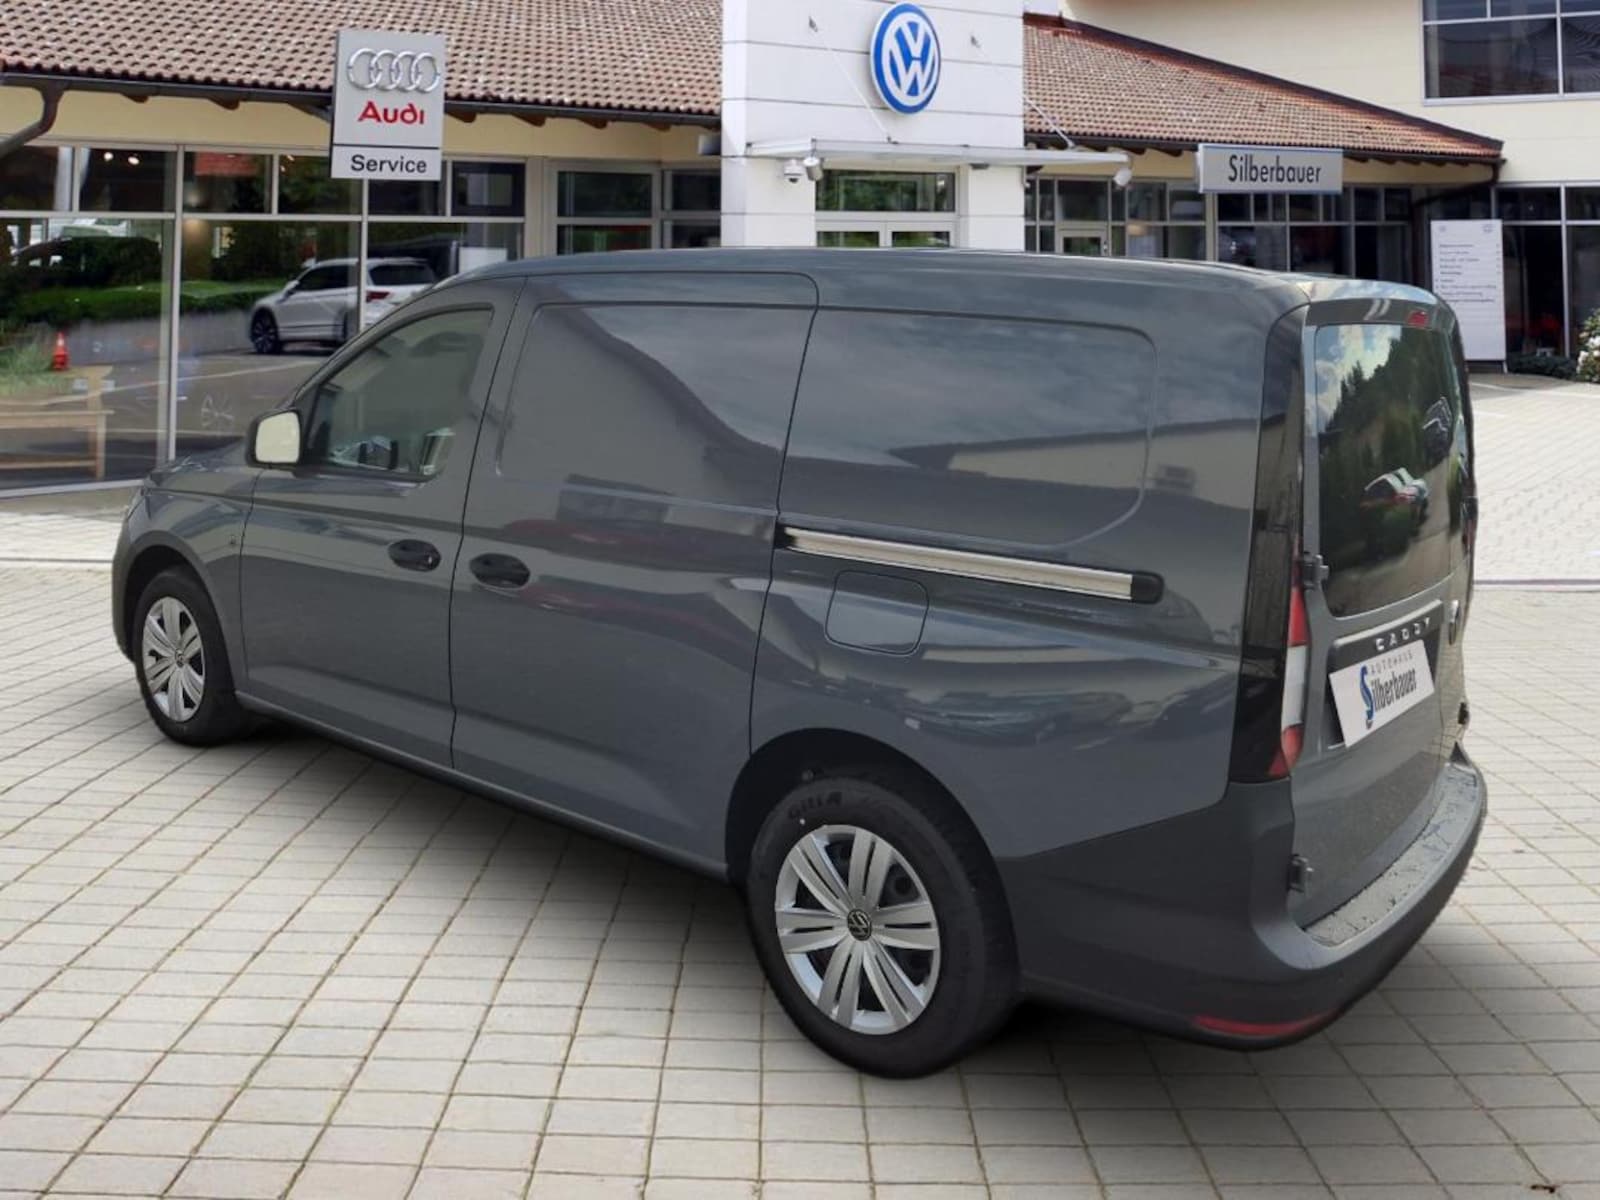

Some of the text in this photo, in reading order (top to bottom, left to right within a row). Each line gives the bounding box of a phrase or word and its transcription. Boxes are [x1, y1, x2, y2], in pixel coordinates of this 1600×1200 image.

[357, 100, 424, 124] Audi
[351, 154, 427, 173] Service
[1228, 154, 1321, 183] Silberbauer
[1375, 617, 1431, 651] CADDY
